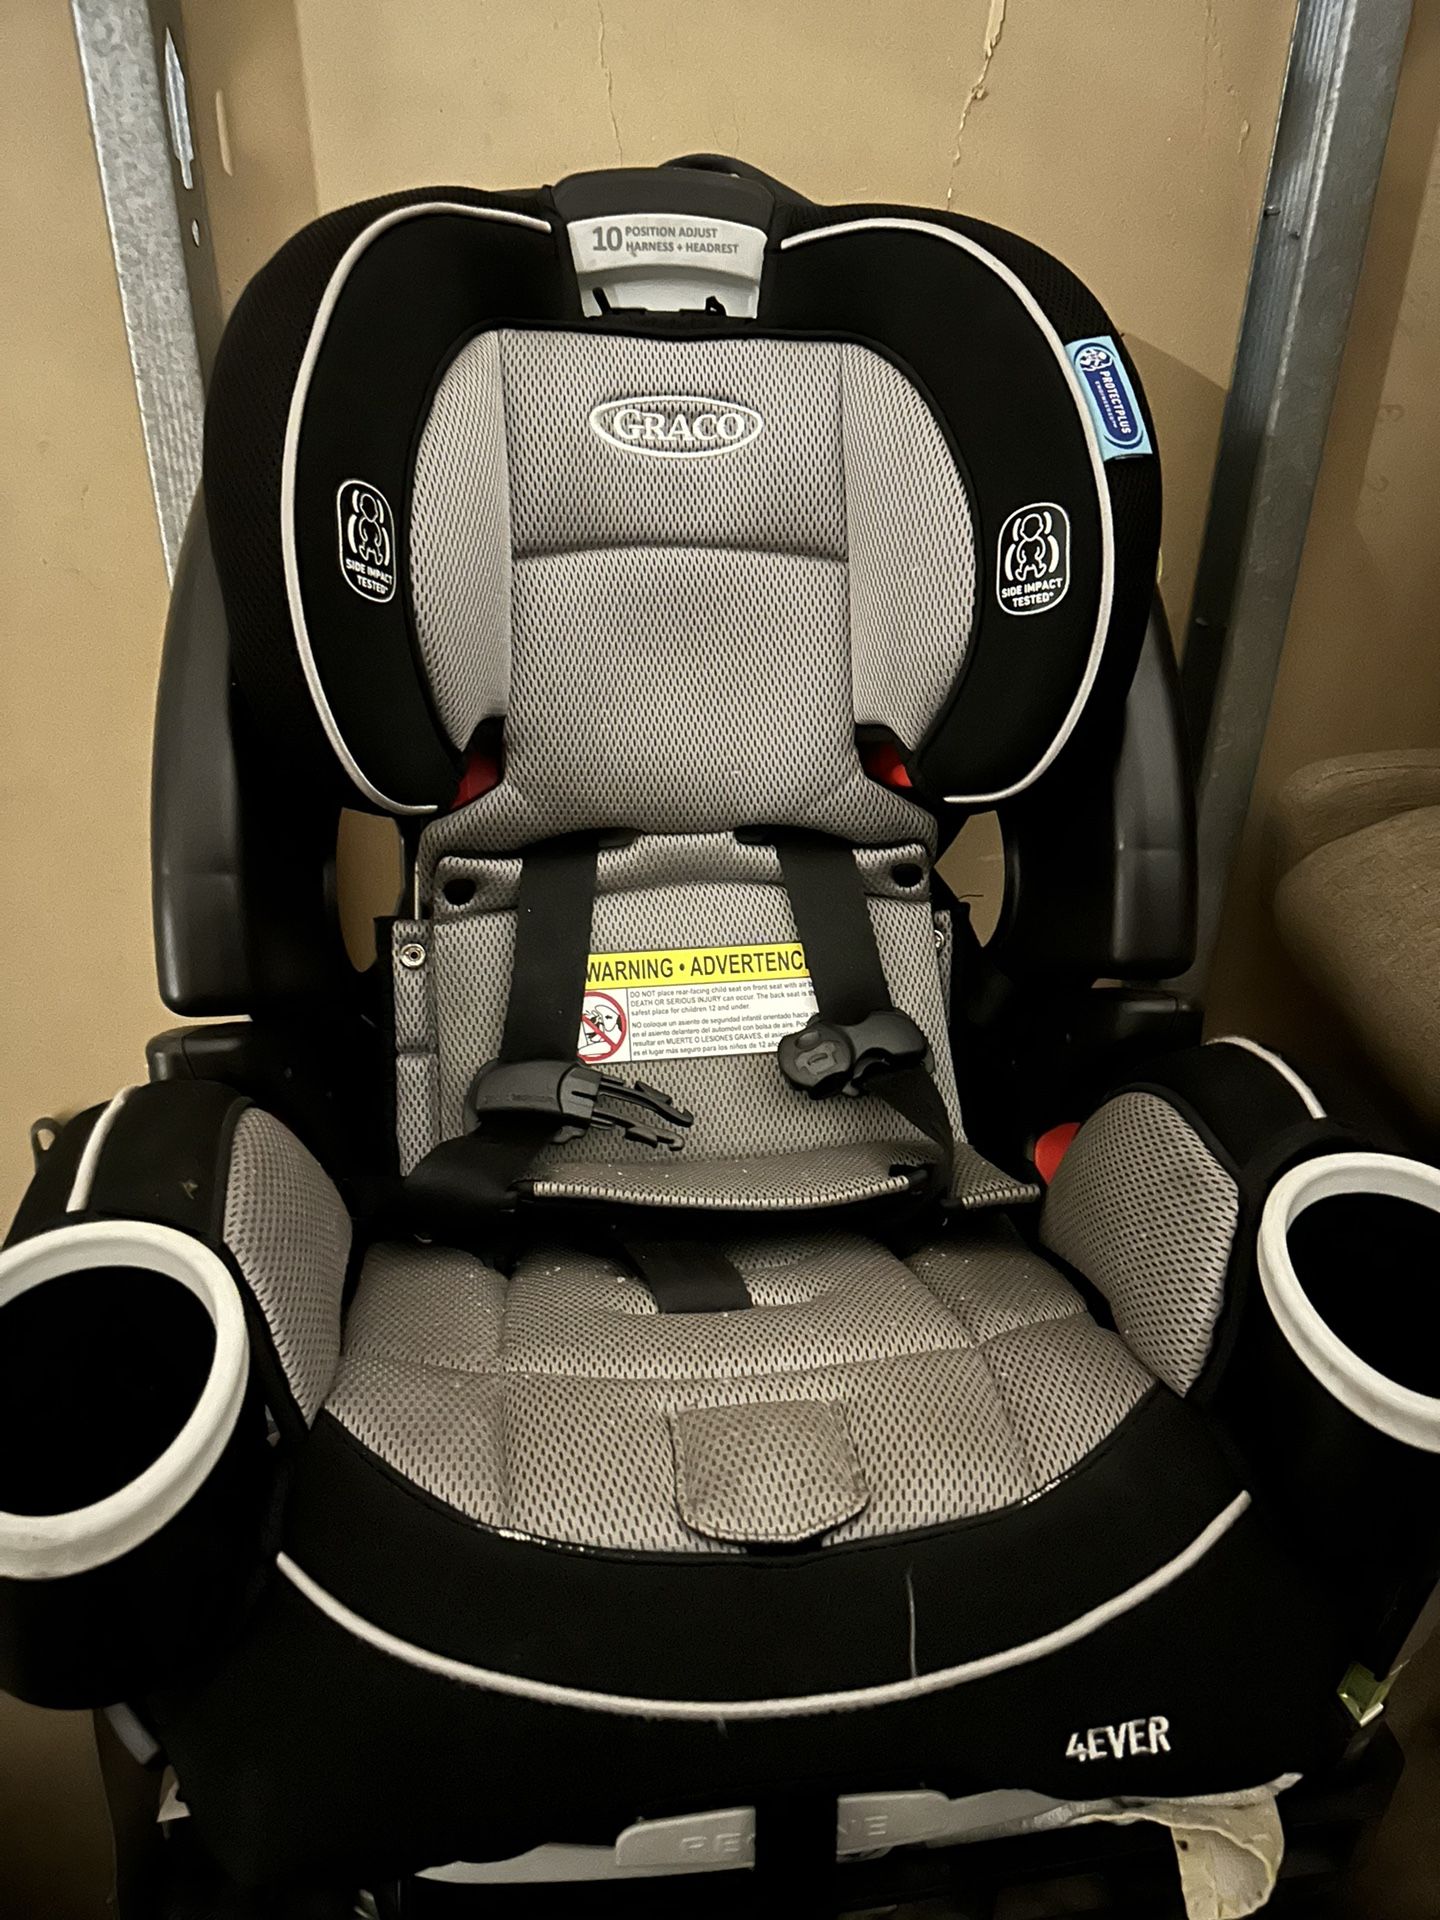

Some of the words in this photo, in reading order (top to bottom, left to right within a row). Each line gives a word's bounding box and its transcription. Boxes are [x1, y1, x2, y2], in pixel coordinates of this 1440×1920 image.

[592, 226, 623, 252] 10
[625, 226, 676, 238] POSITION
[678, 227, 718, 239] ADJUST
[626, 241, 675, 252] HARNESS
[686, 242, 739, 254] HEADREST
[1100, 370, 1132, 434] PROTECTPLUS
[613, 408, 745, 442] GRACO
[345, 557, 366, 574] SIDE
[367, 565, 393, 585] IMPACT
[1001, 585, 1023, 598] SIDE
[1024, 577, 1063, 594] IMPACT
[587, 957, 674, 982] WARNING
[690, 950, 807, 976] ADVERTENC
[630, 999, 653, 1007] DEATH
[666, 997, 696, 1005] SERIOUS
[697, 995, 721, 1003] INJURY
[657, 990, 674, 998] place
[676, 988, 710, 996] rear-facing
[652, 1008, 669, 1016] place
[681, 1006, 707, 1014] children
[648, 1029, 670, 1037] asiento
[671, 1028, 700, 1036] delantero
[700, 1034, 733, 1042] LESIONES
[648, 1048, 664, 1056] lugar
[1065, 1715, 1172, 1762] 4EVER
